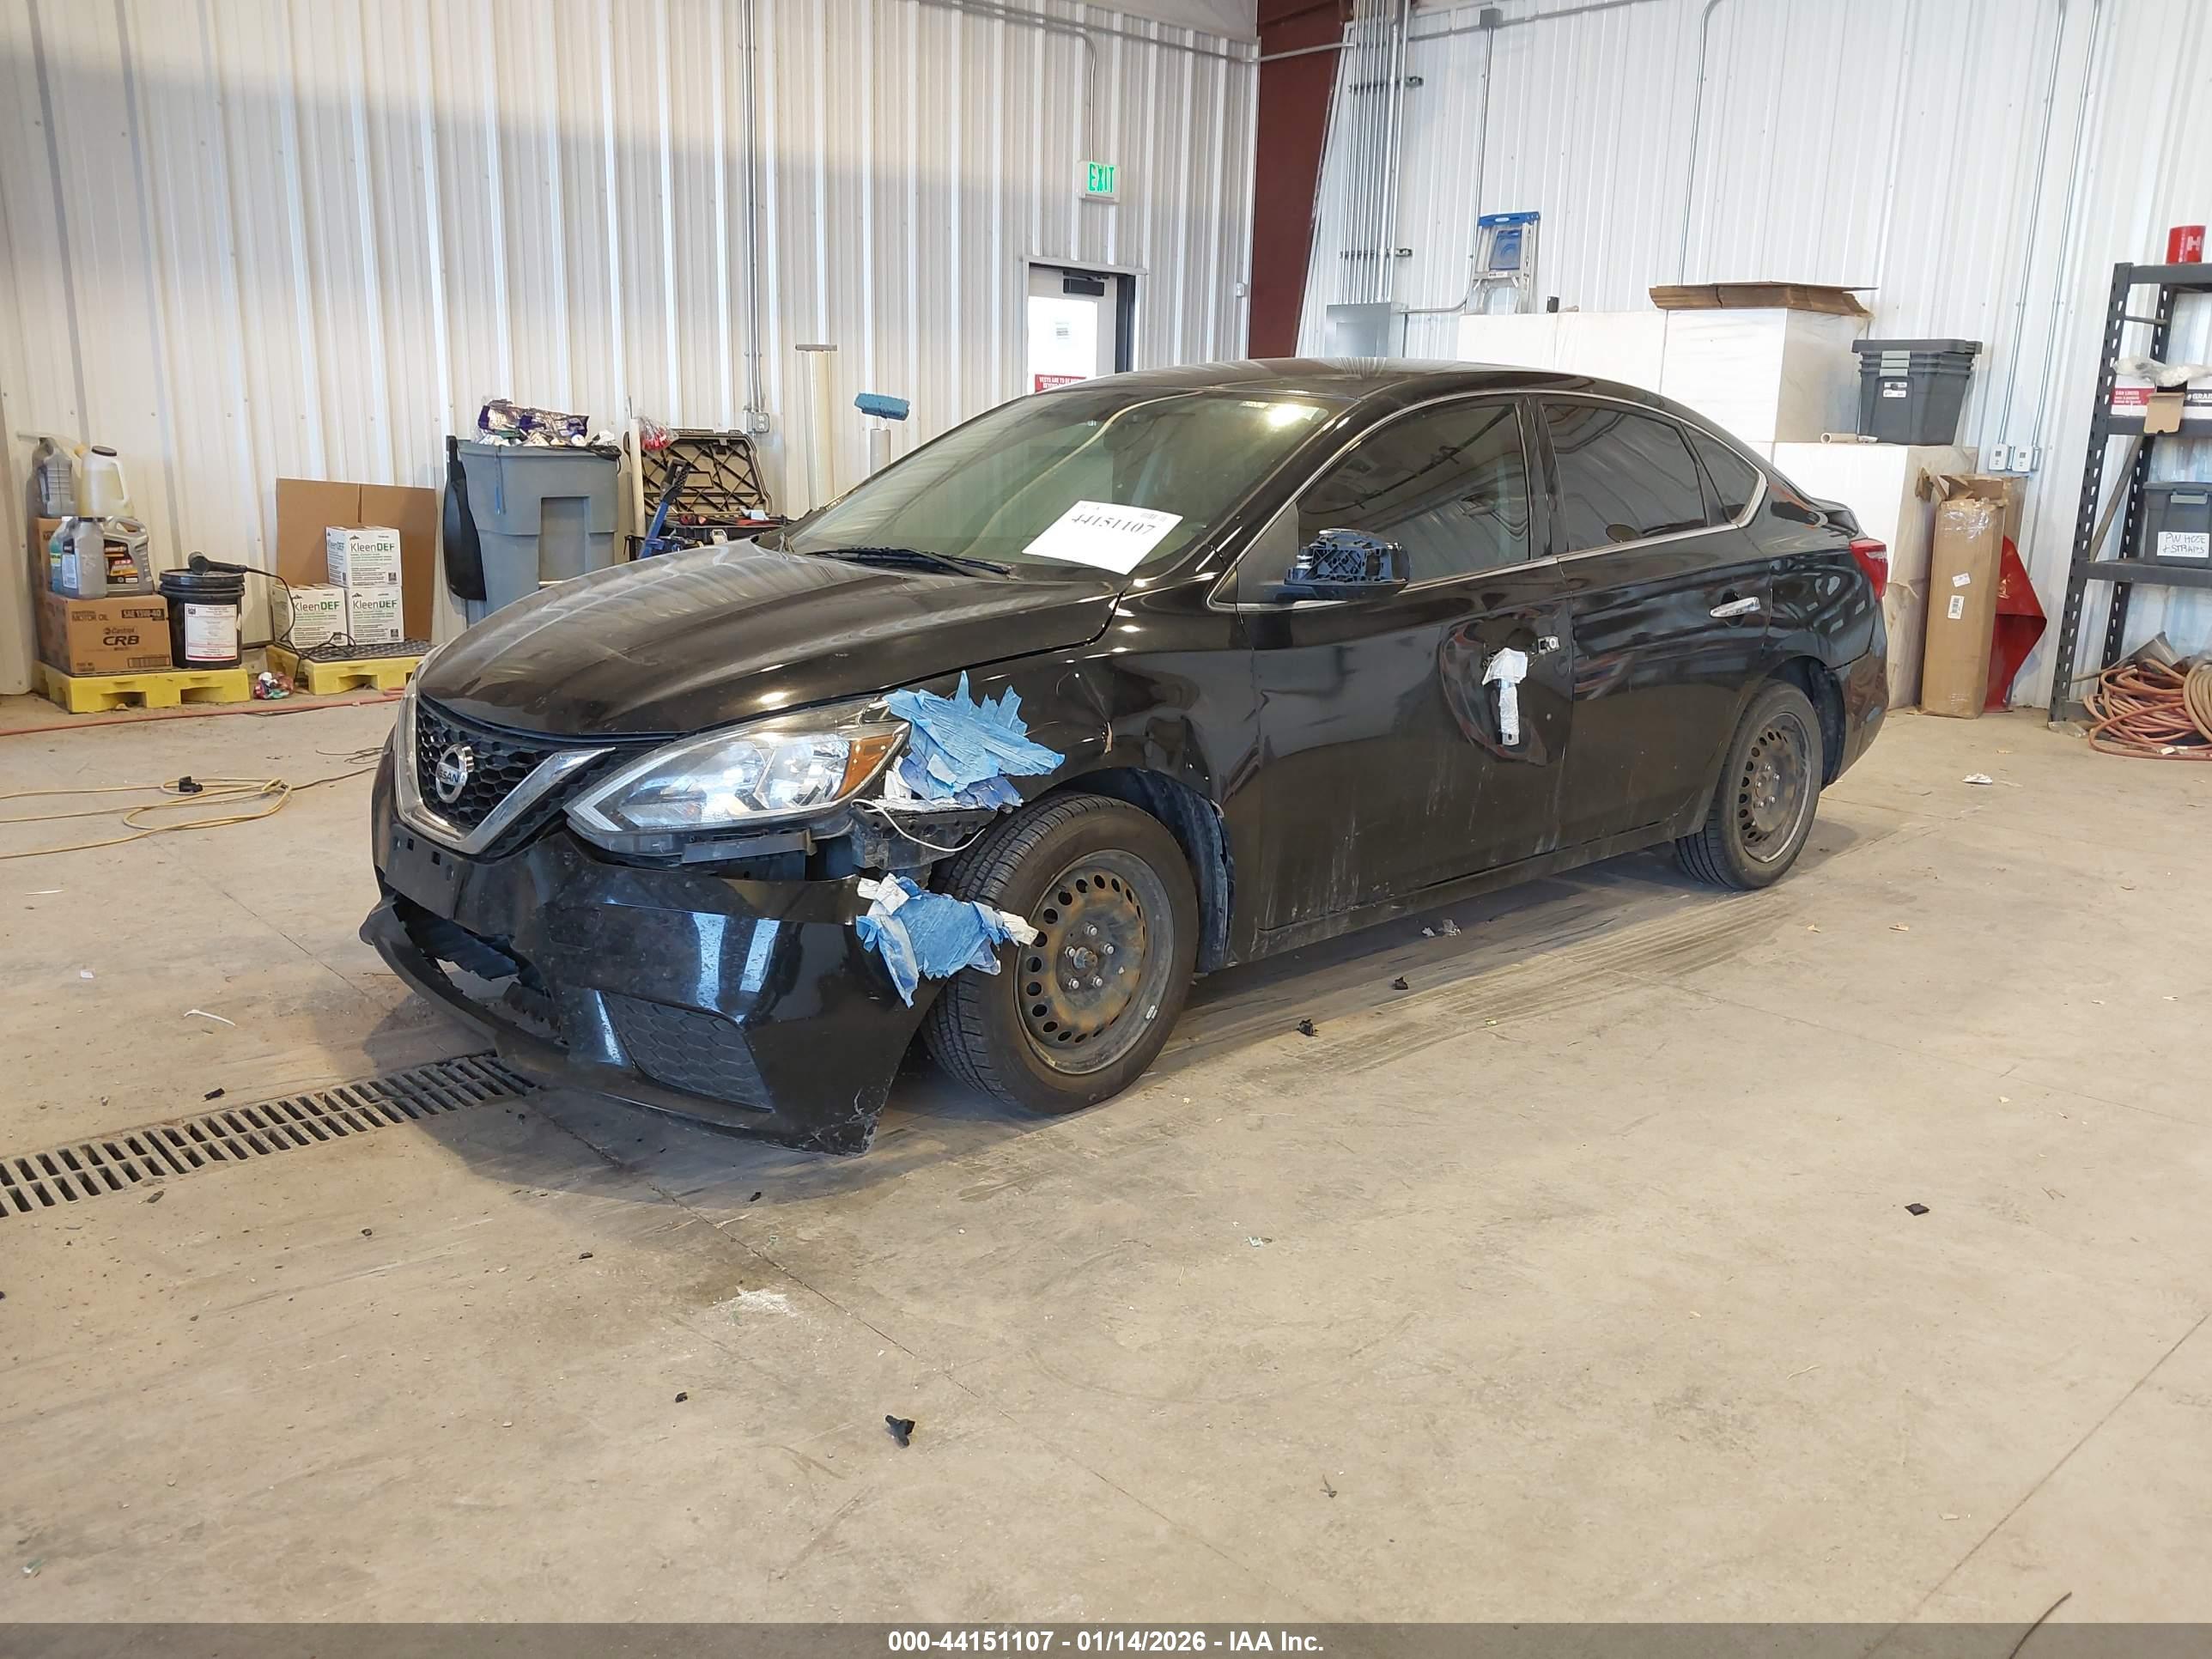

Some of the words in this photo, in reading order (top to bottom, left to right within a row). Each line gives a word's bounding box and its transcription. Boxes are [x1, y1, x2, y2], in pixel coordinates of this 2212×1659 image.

[1089, 163, 1115, 192] EXIT
[1072, 514, 1156, 534] 44151107
[2166, 532, 2181, 543] PW
[350, 543, 395, 552] KleenDEF
[353, 599, 398, 609] KleenDEF
[103, 635, 139, 647] CRB
